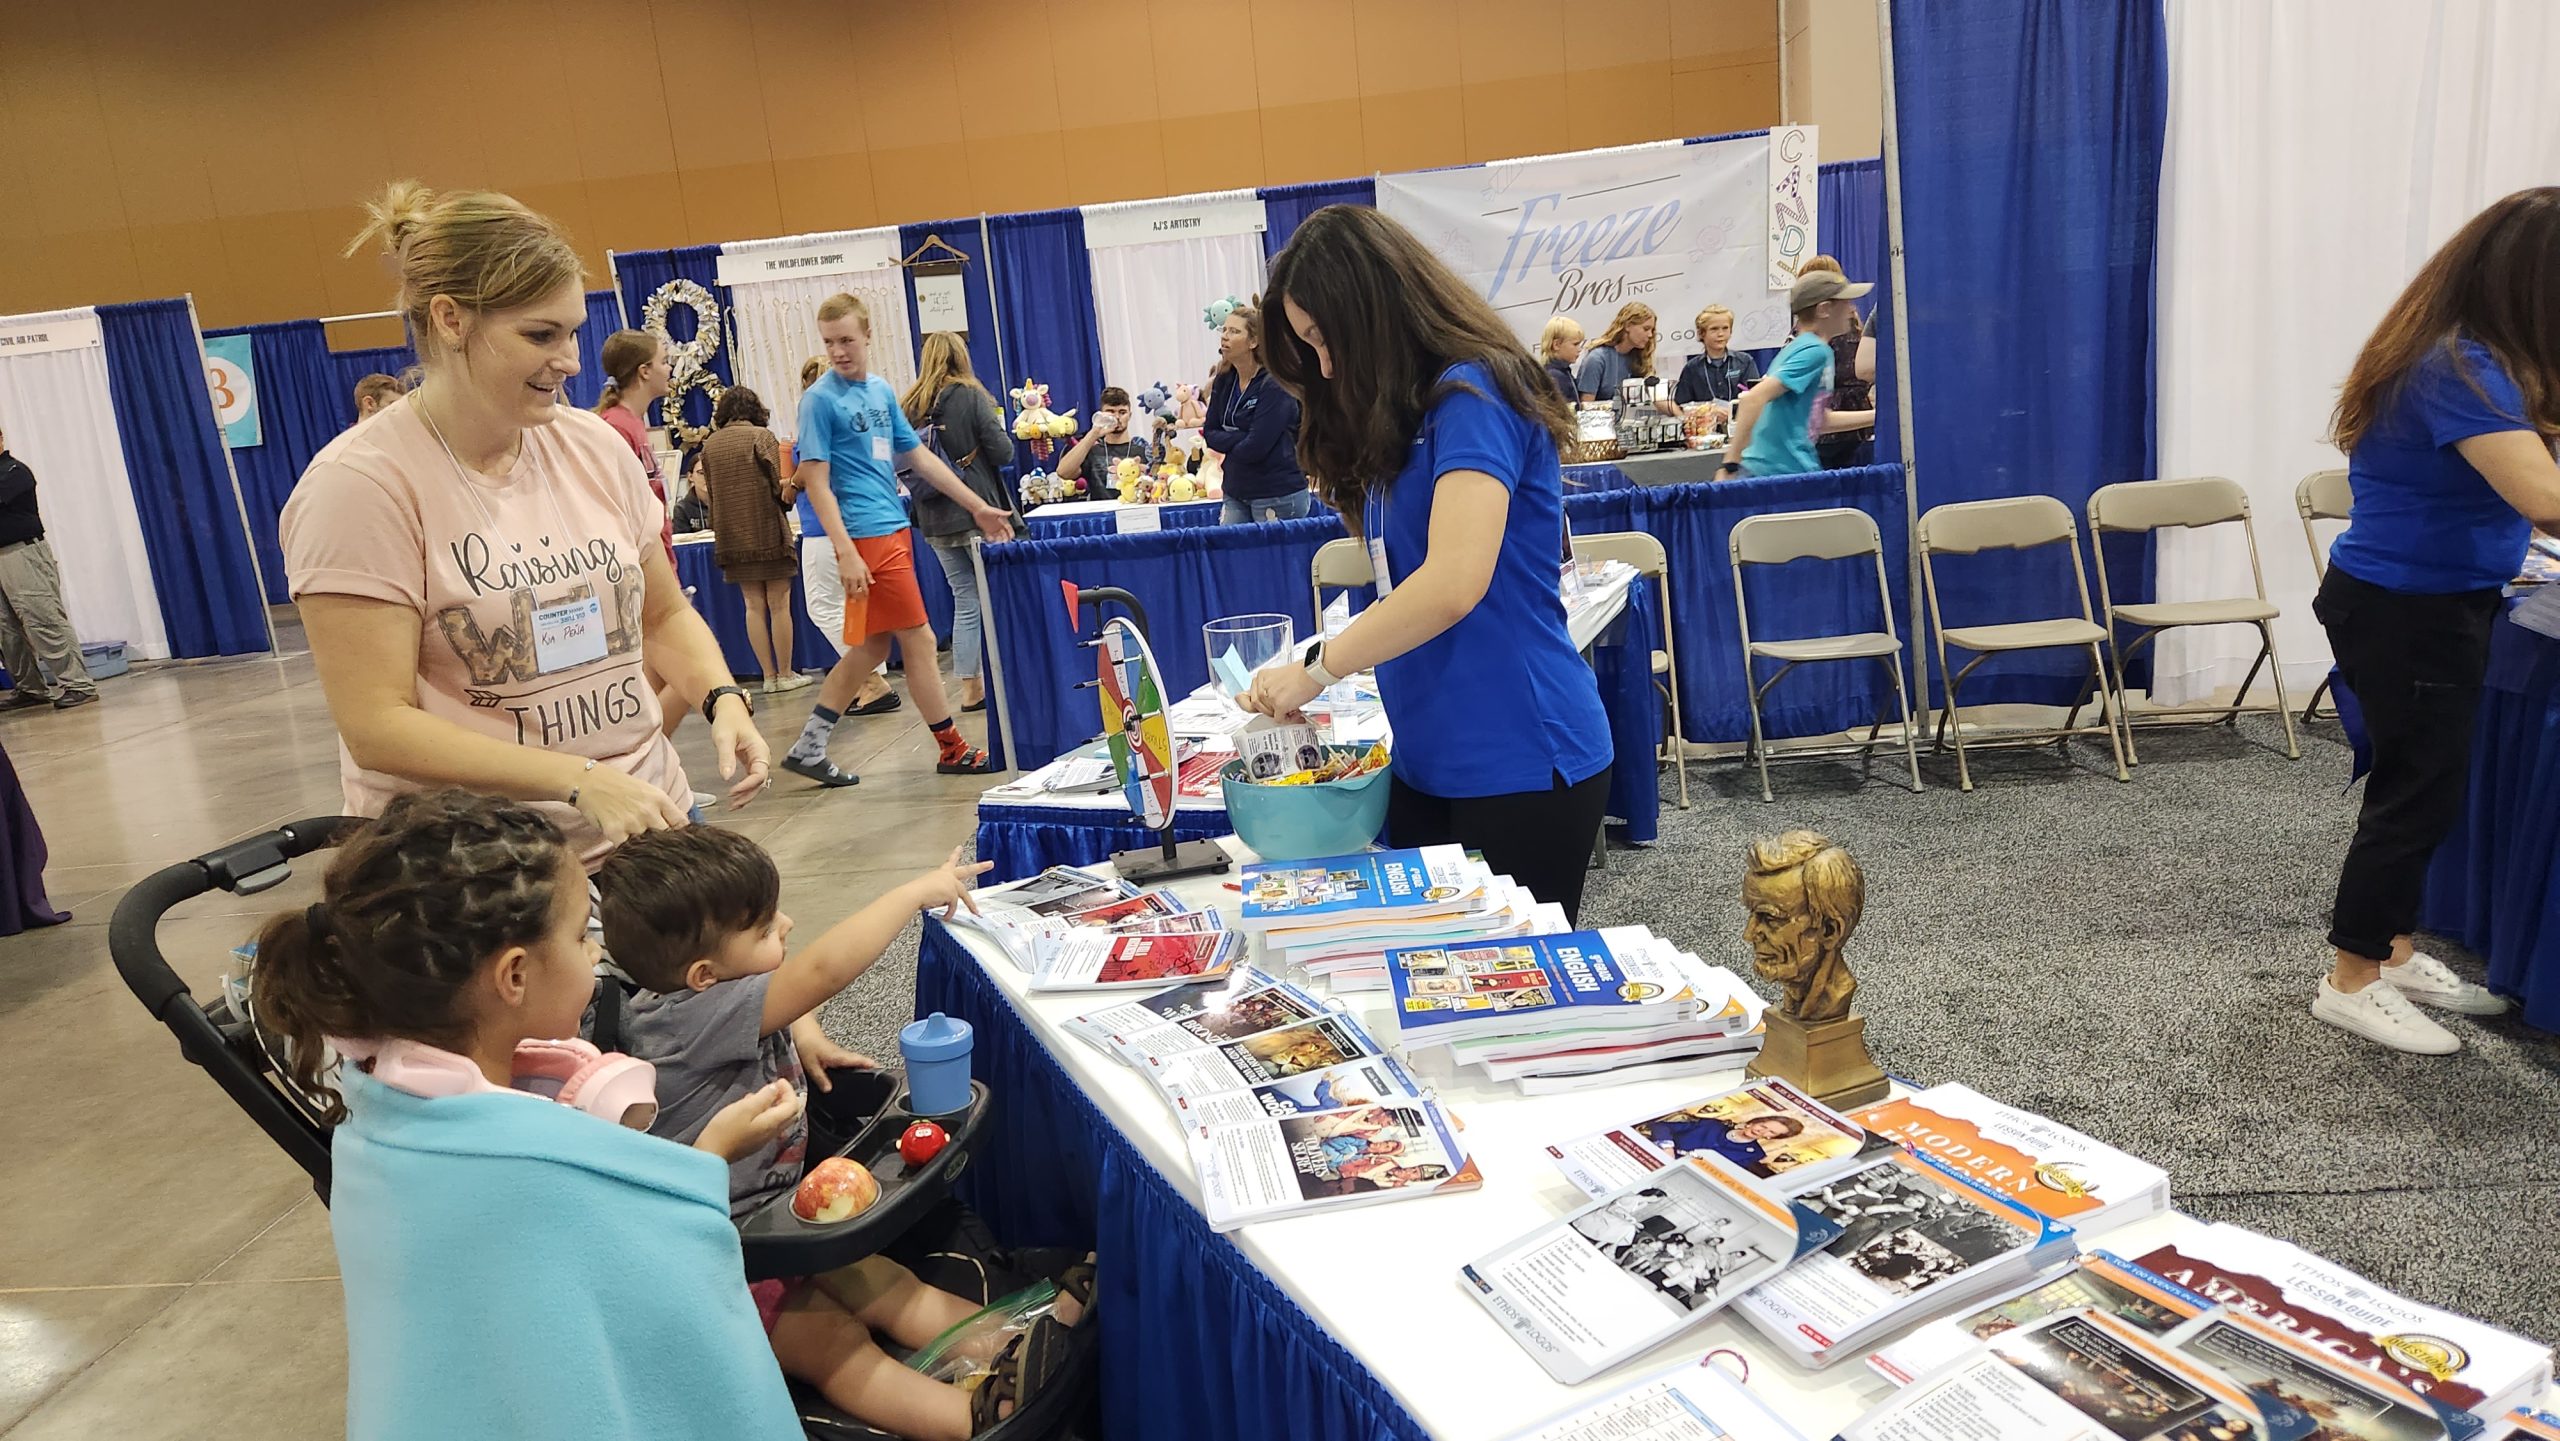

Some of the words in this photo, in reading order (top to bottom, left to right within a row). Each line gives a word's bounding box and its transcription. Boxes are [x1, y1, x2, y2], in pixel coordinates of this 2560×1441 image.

[1153, 220, 1168, 231] AJ'S
[1170, 217, 1201, 230] ARTISTRY
[1775, 130, 1809, 277] CANDY
[765, 260, 777, 271] THE
[779, 256, 819, 269] WILDFLOWER
[820, 254, 844, 265] SHOPPE
[1487, 193, 1682, 301] Freeze
[1550, 268, 1626, 315] Bros
[1627, 282, 1658, 297] INC.
[450, 532, 624, 597] Raising
[436, 563, 645, 687] WD
[539, 609, 568, 621] COUNTER
[504, 676, 641, 746] THINGS
[1384, 862, 1412, 897] ENGLISH
[1556, 946, 1601, 993] ENGLISH
[1182, 1020, 1220, 1044] BRONZ
[1223, 1047, 1240, 1062] AND
[1260, 1091, 1284, 1116] WOO
[1279, 1100, 1299, 1115] CA
[1290, 1141, 1315, 1174] SECRET
[1303, 1134, 1330, 1177] TOLIVER'S
[1898, 1121, 2040, 1192] MODERN
[2112, 1258, 2131, 1271] TOP
[2131, 1267, 2148, 1279] 100
[2148, 1273, 2181, 1296] EVENTS
[2180, 1290, 2192, 1301] IN
[2189, 1295, 2211, 1311] HIS
[2286, 1276, 2345, 1309] LESSON
[2346, 1303, 2395, 1328] GUIDE
[2292, 1262, 2342, 1289] ETHOS
[2369, 1298, 2427, 1325] LOGOS
[1493, 1295, 1520, 1320] ETHOS
[1760, 1296, 1791, 1319] LOGOS
[2163, 1269, 2433, 1395] AMERICA'S
[2388, 1336, 2451, 1376] QUESTIONS
